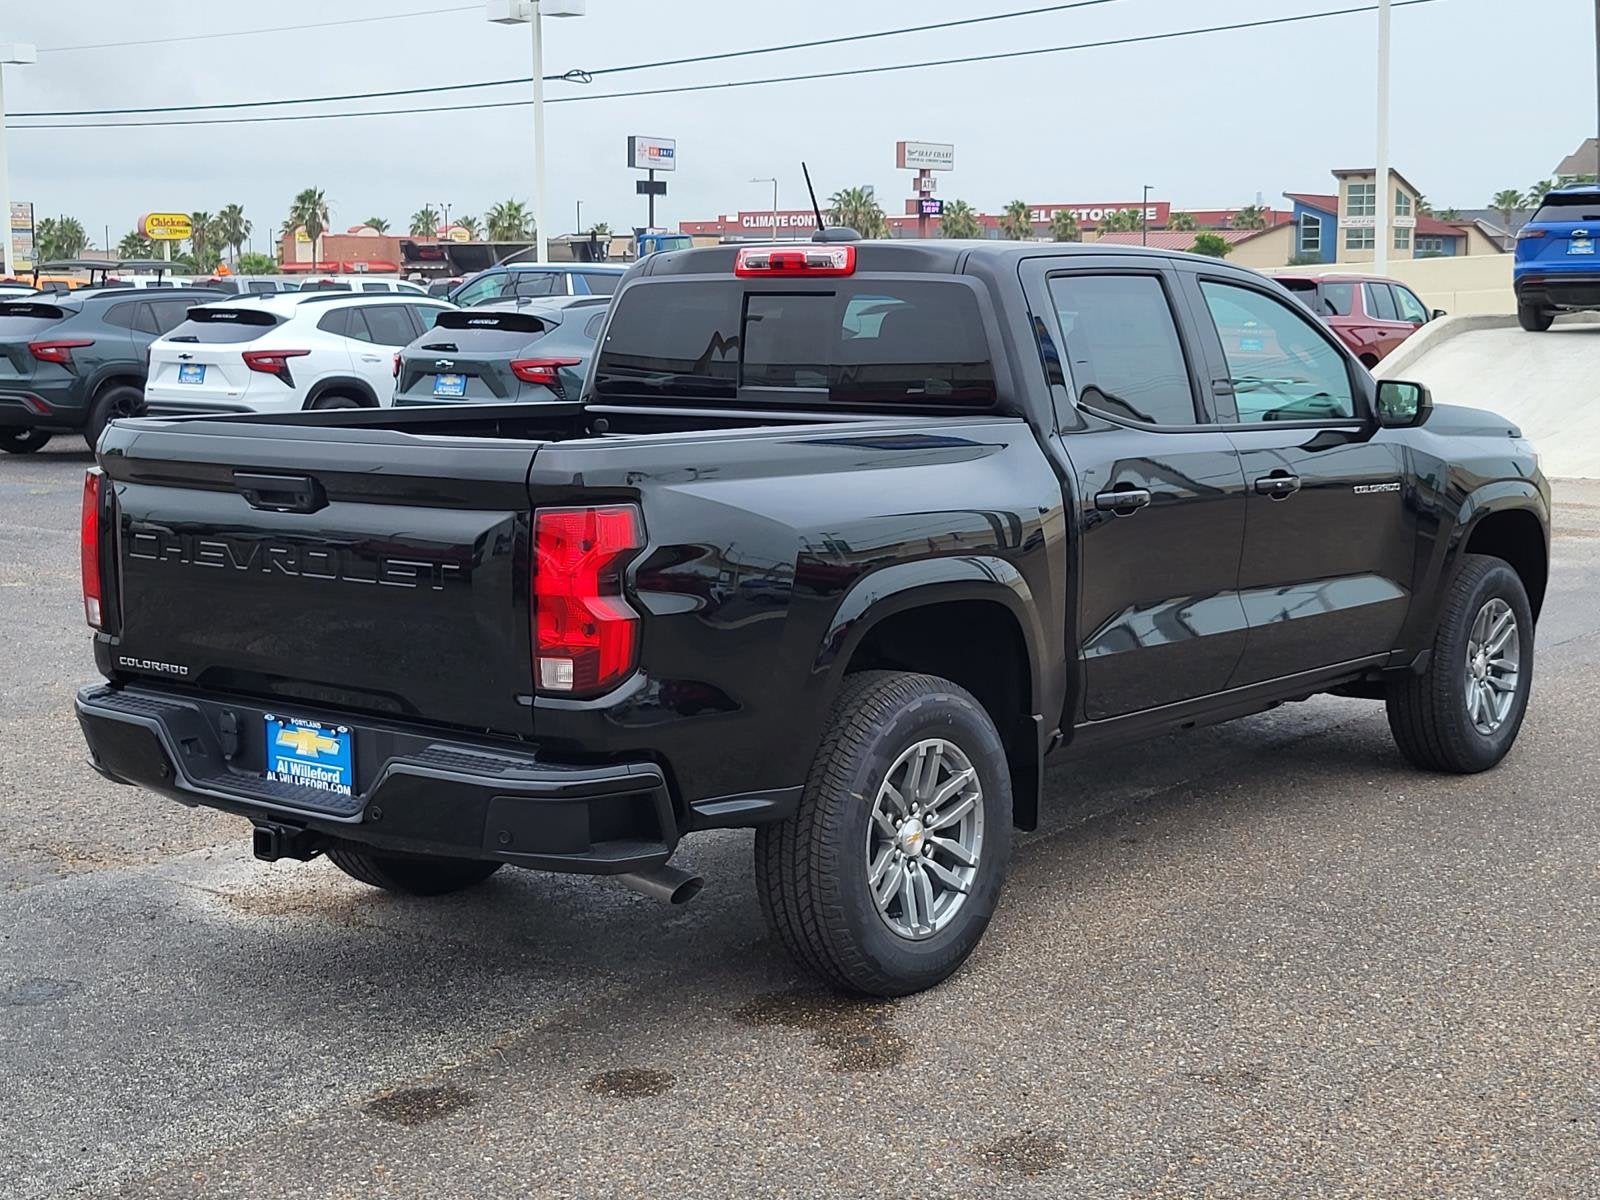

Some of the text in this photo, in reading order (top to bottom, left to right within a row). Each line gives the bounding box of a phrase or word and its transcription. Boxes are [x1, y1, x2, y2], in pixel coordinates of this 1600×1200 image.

[923, 180, 936, 190] ATM
[151, 217, 187, 227] Chicken
[743, 216, 788, 227] CLIMATE
[1353, 482, 1400, 494] COLORADO
[129, 533, 460, 590] CHEVROLET
[119, 656, 188, 675] COLORADO
[290, 718, 322, 729] PORTLAND
[277, 760, 341, 783] Al Willeford
